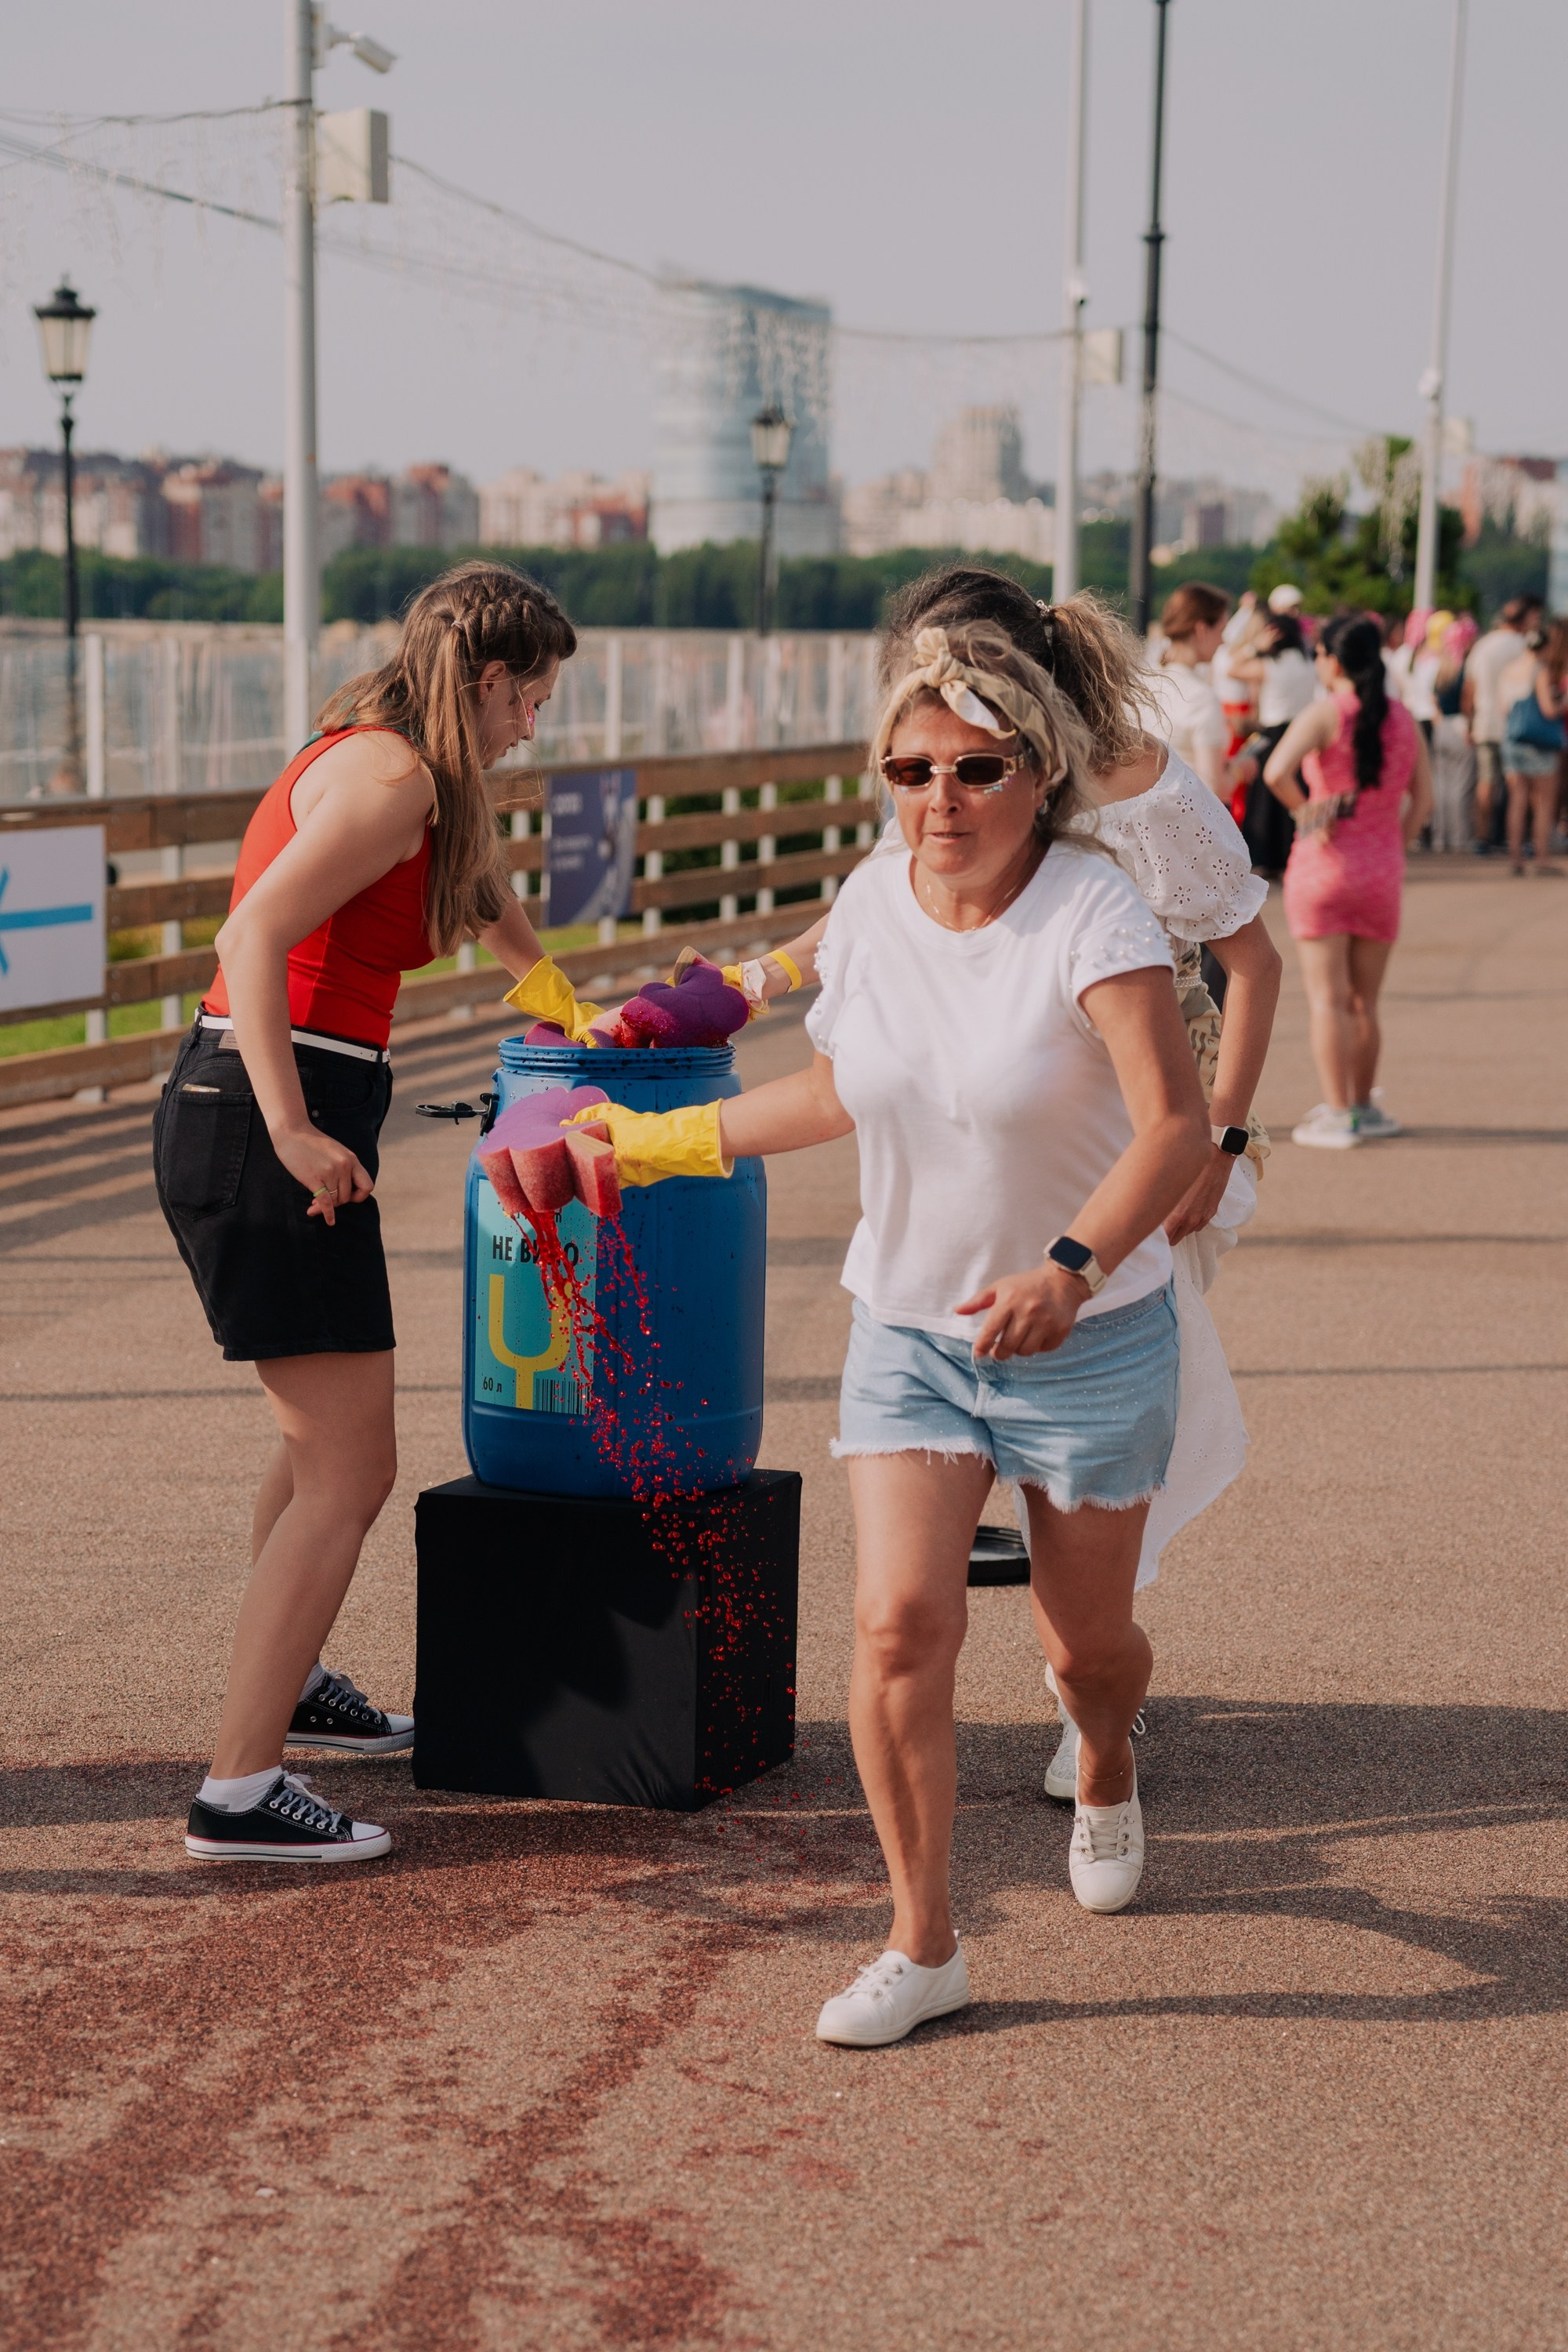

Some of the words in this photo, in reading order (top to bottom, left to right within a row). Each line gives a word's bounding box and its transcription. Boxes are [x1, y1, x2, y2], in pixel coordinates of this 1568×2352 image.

[492, 1235, 513, 1261] НЕ
[483, 1376, 494, 1392] 60
[495, 1382, 503, 1393] л
